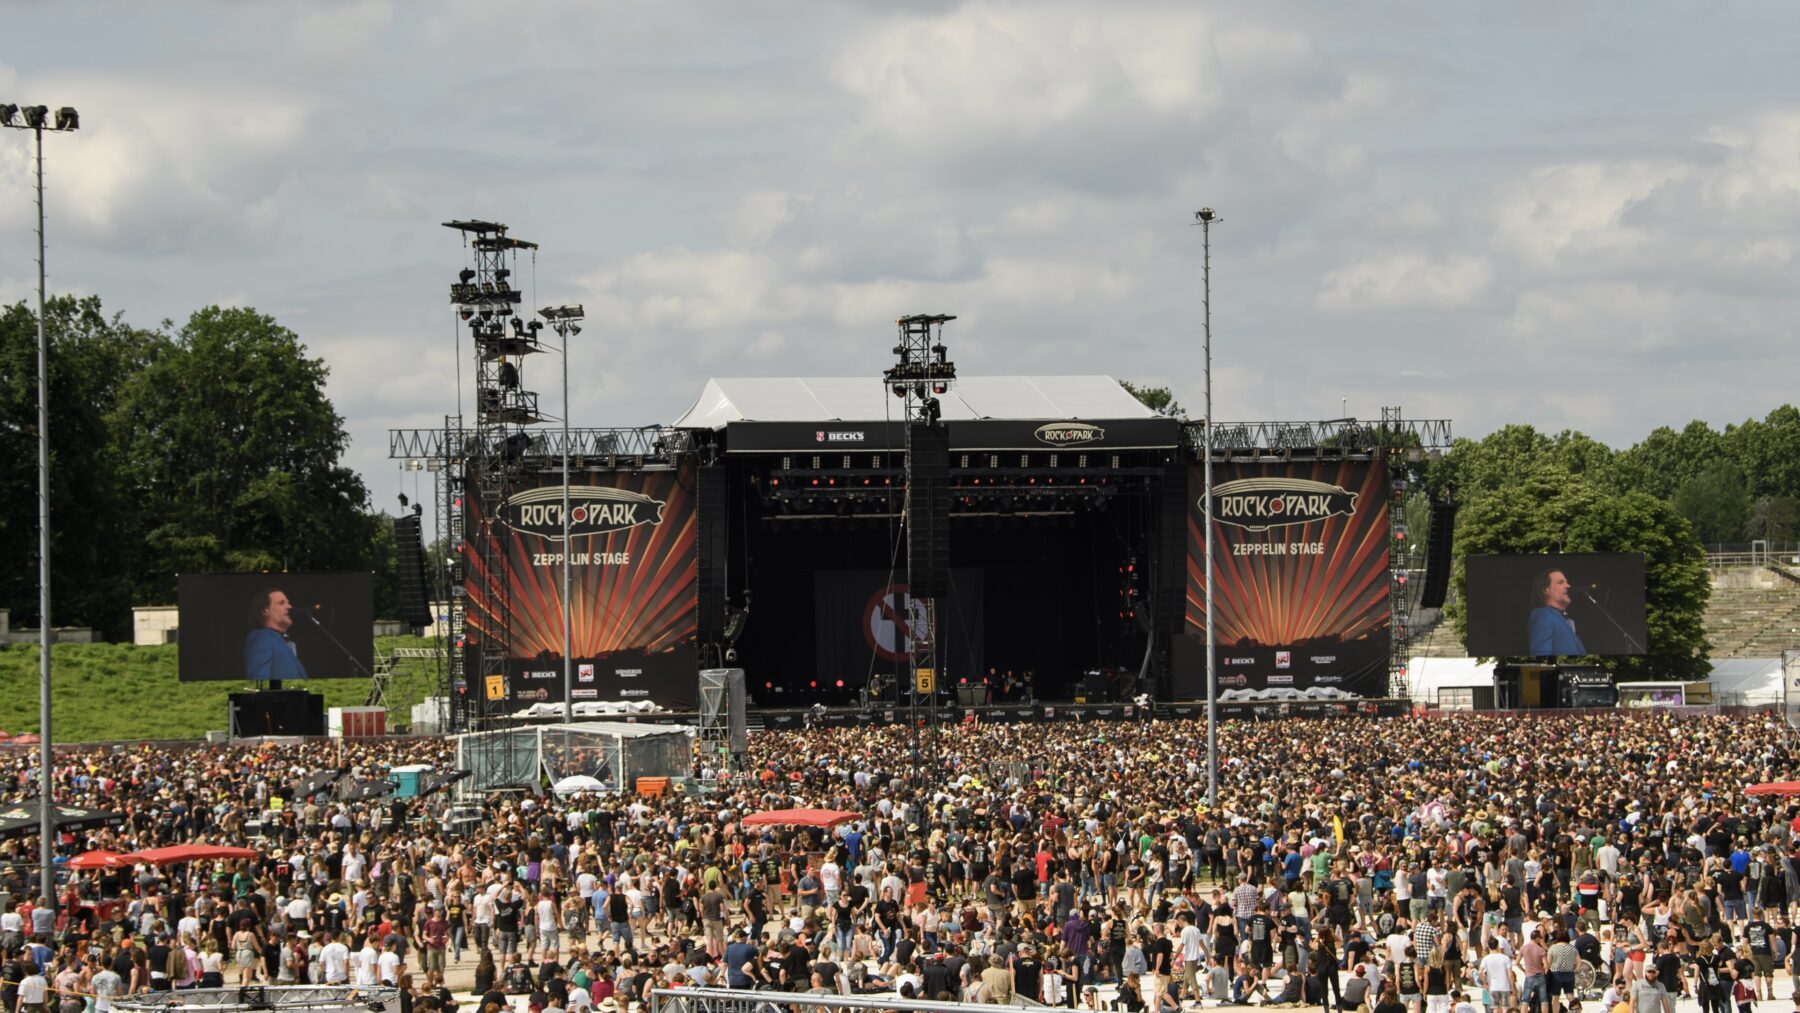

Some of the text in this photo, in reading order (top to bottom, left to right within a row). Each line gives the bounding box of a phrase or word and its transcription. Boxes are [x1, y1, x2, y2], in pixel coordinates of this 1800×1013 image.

[828, 431, 865, 441] BECK'S
[1045, 430, 1094, 440] ROCK PARK
[1222, 495, 1332, 517] ROCK PARK
[589, 503, 637, 525] PARK
[1233, 542, 1324, 556] ZEPPELIN STAGE
[533, 552, 630, 566] ZEPPLIN STAGE
[921, 678, 929, 688] 5
[492, 685, 498, 695] 1
